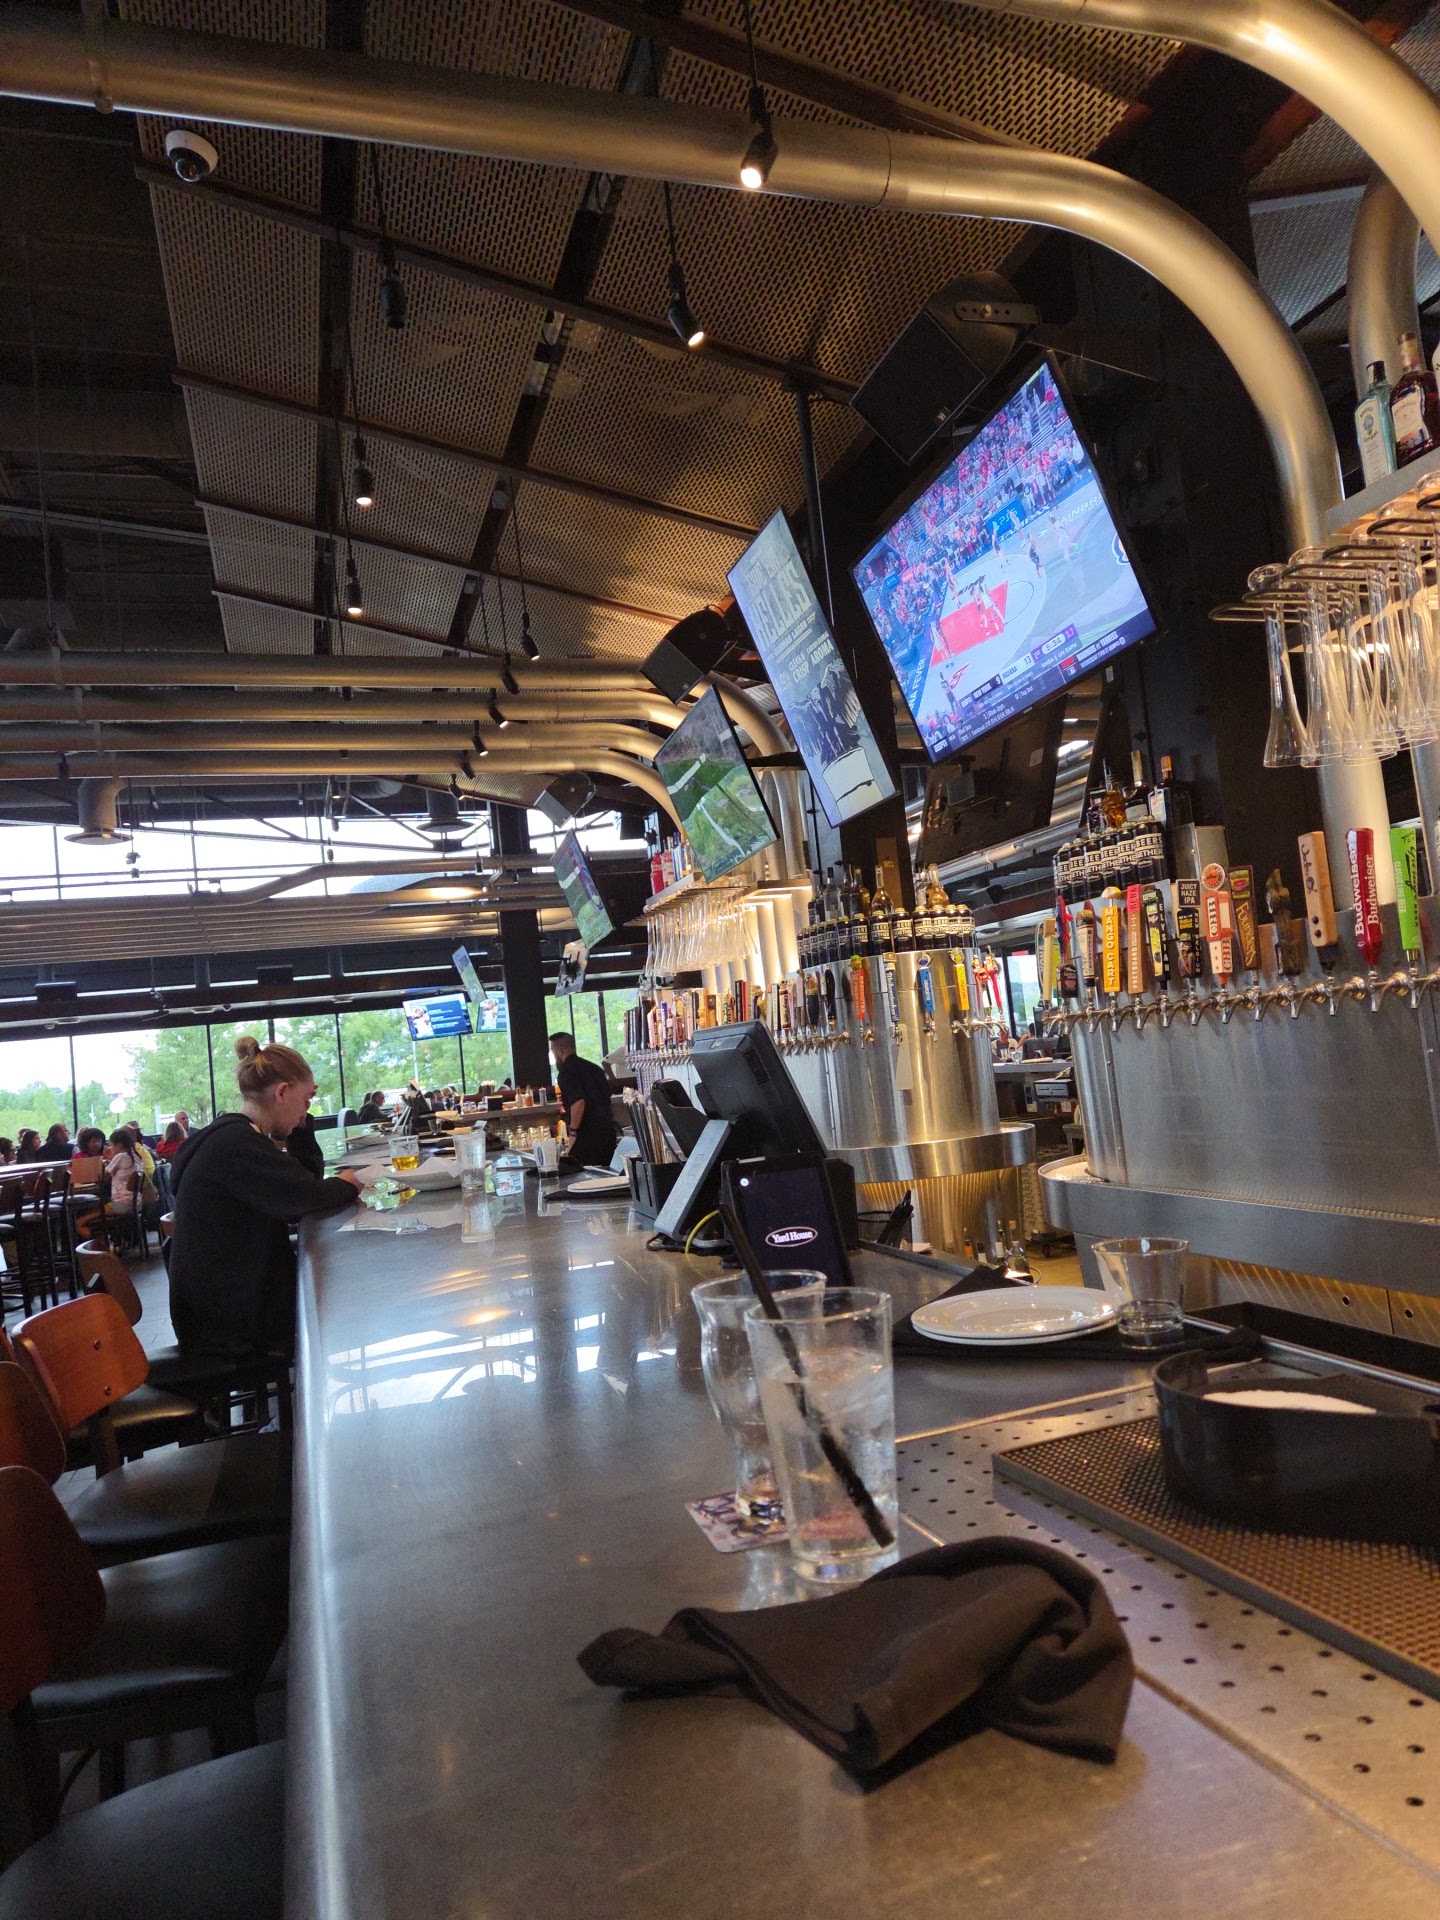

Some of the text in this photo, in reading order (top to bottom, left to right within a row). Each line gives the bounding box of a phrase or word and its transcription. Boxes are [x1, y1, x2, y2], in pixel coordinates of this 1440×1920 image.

[746, 557, 812, 652] HELLES
[810, 640, 834, 667] AROMA
[1024, 655, 1032, 665] 13
[1136, 836, 1163, 847] BEERS
[1184, 896, 1195, 904] IPA
[1364, 854, 1379, 925] Budweiser
[1105, 908, 1116, 986] MANGO CART
[1159, 903, 1170, 971] ELYSIAN
[1236, 901, 1257, 967] Founders
[1131, 947, 1139, 989] FRETBOARD
[772, 1231, 814, 1244] Yard House
